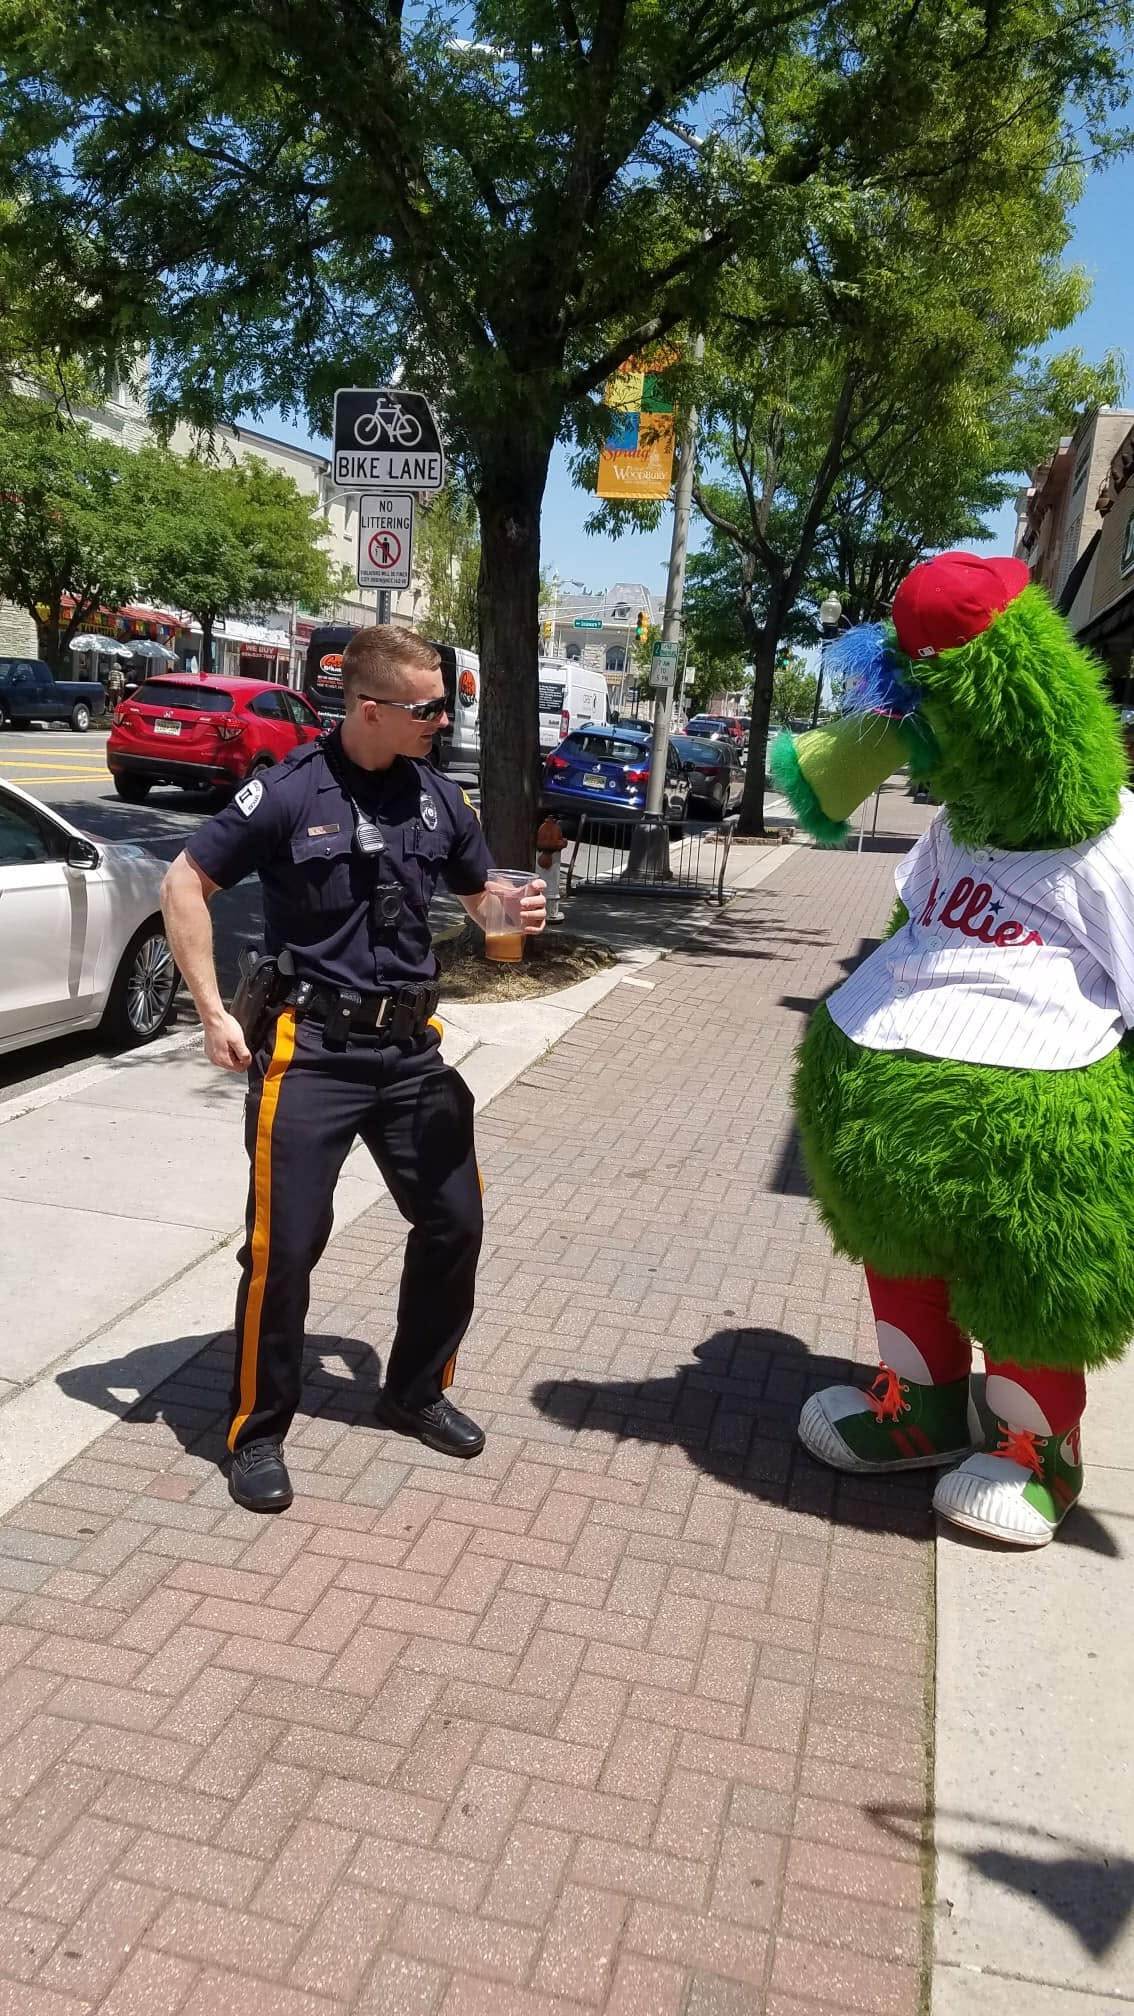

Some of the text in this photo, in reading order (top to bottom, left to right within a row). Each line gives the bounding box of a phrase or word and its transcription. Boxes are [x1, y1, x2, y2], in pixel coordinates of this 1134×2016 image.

[603, 443, 651, 463] Spring
[338, 456, 439, 481] BIKE LANE
[379, 500, 393, 513] NO
[361, 516, 410, 530] LITTERING
[245, 644, 275, 654] WE BUY
[654, 644, 660, 654] 2
